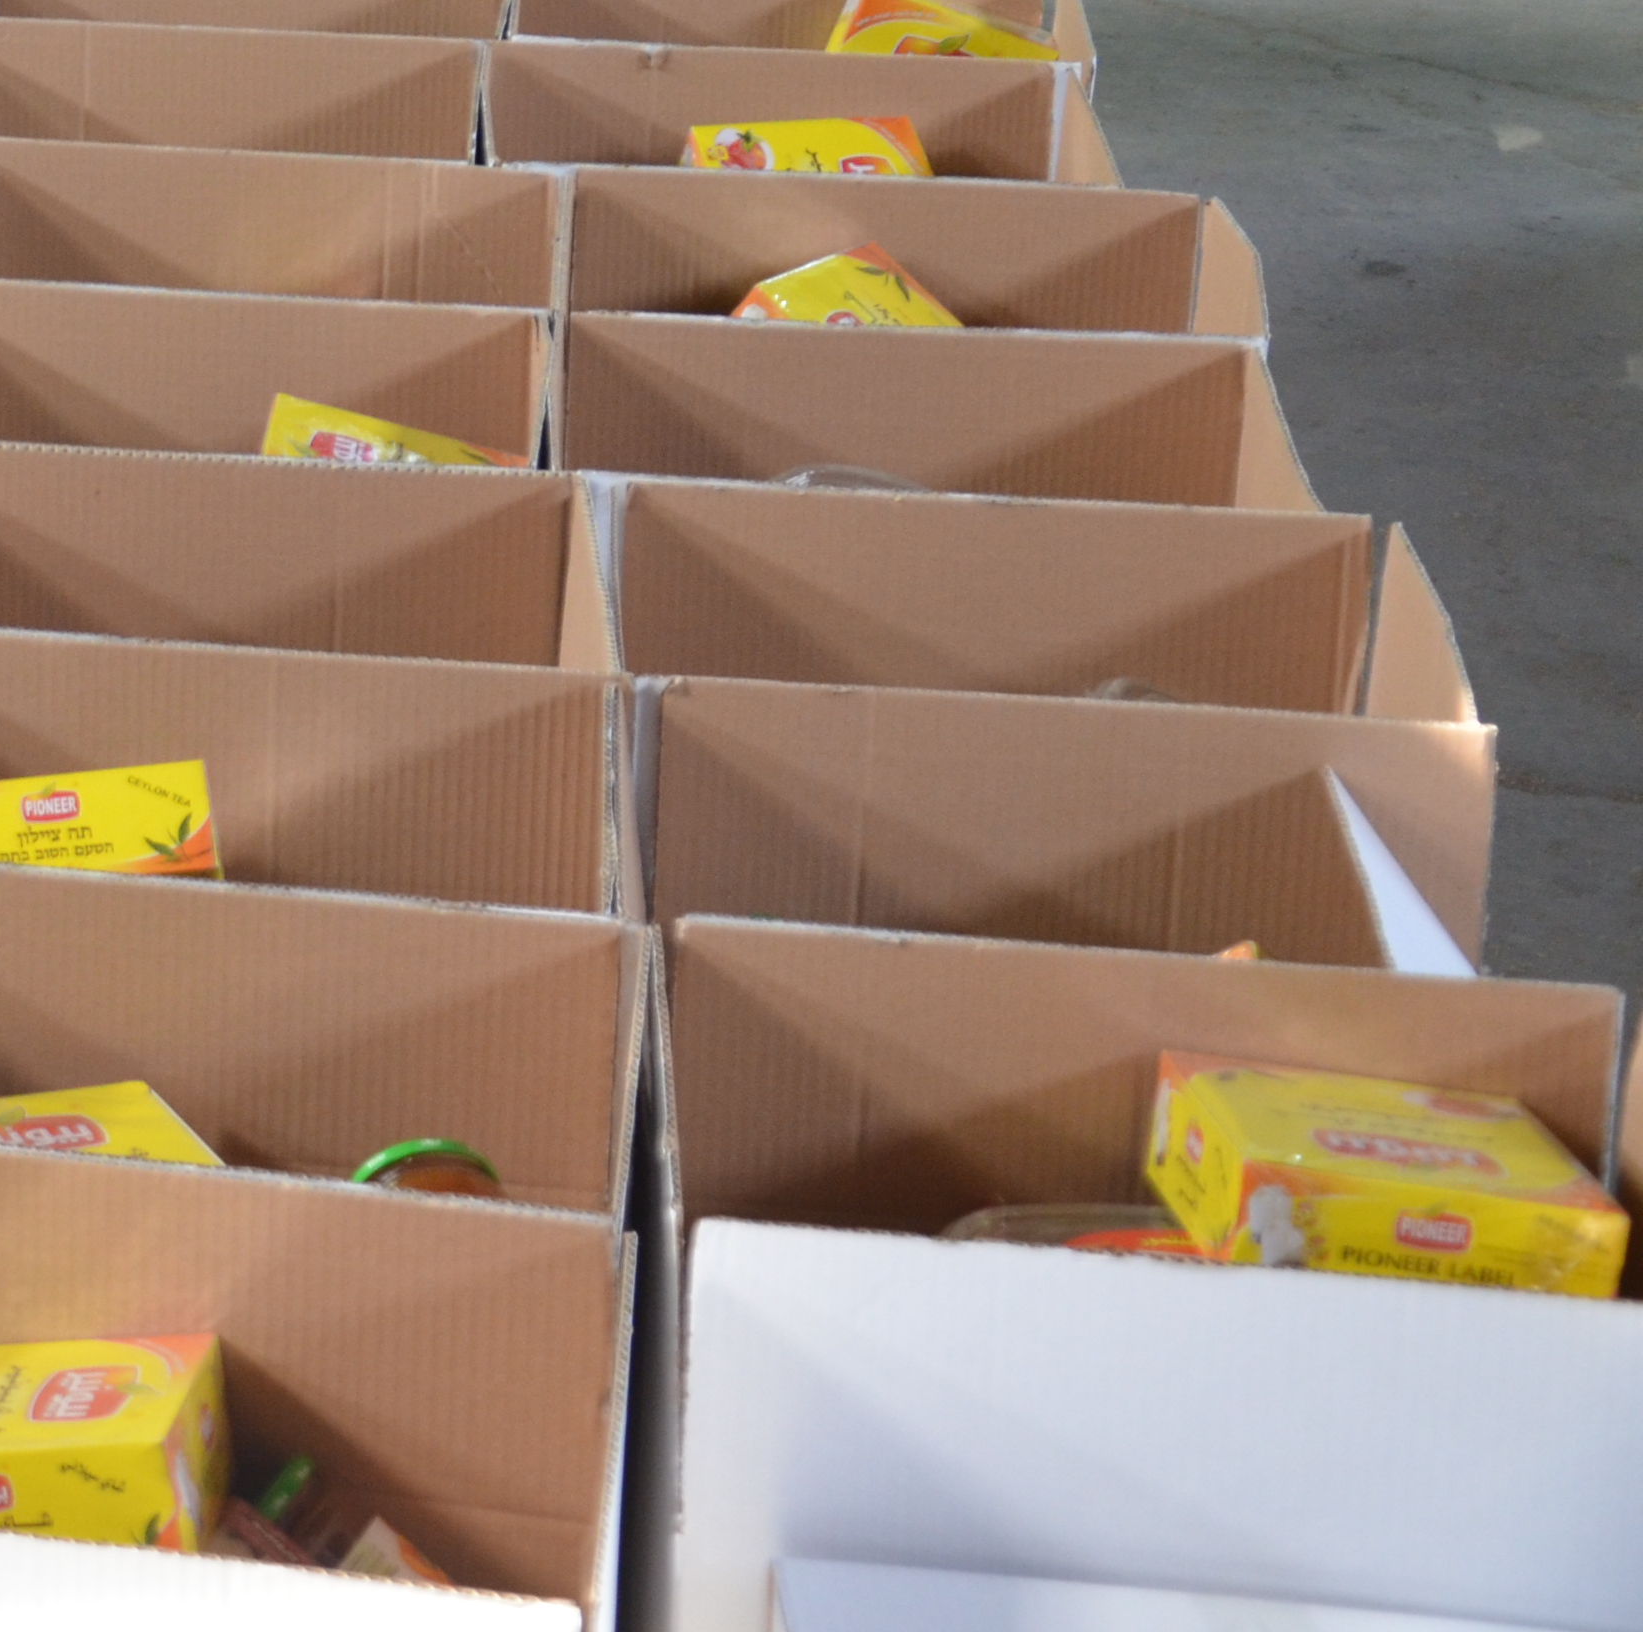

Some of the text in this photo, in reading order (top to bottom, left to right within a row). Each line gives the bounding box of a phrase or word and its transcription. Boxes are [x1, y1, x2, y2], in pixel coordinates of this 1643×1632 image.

[127, 775, 192, 808] CEYLON TEA
[25, 796, 77, 817] PIONEER
[17, 825, 93, 848] תה ציילון
[35, 846, 69, 860] הטוב
[1400, 1216, 1468, 1246] PIONEER
[1341, 1245, 1441, 1275] PIONEER
